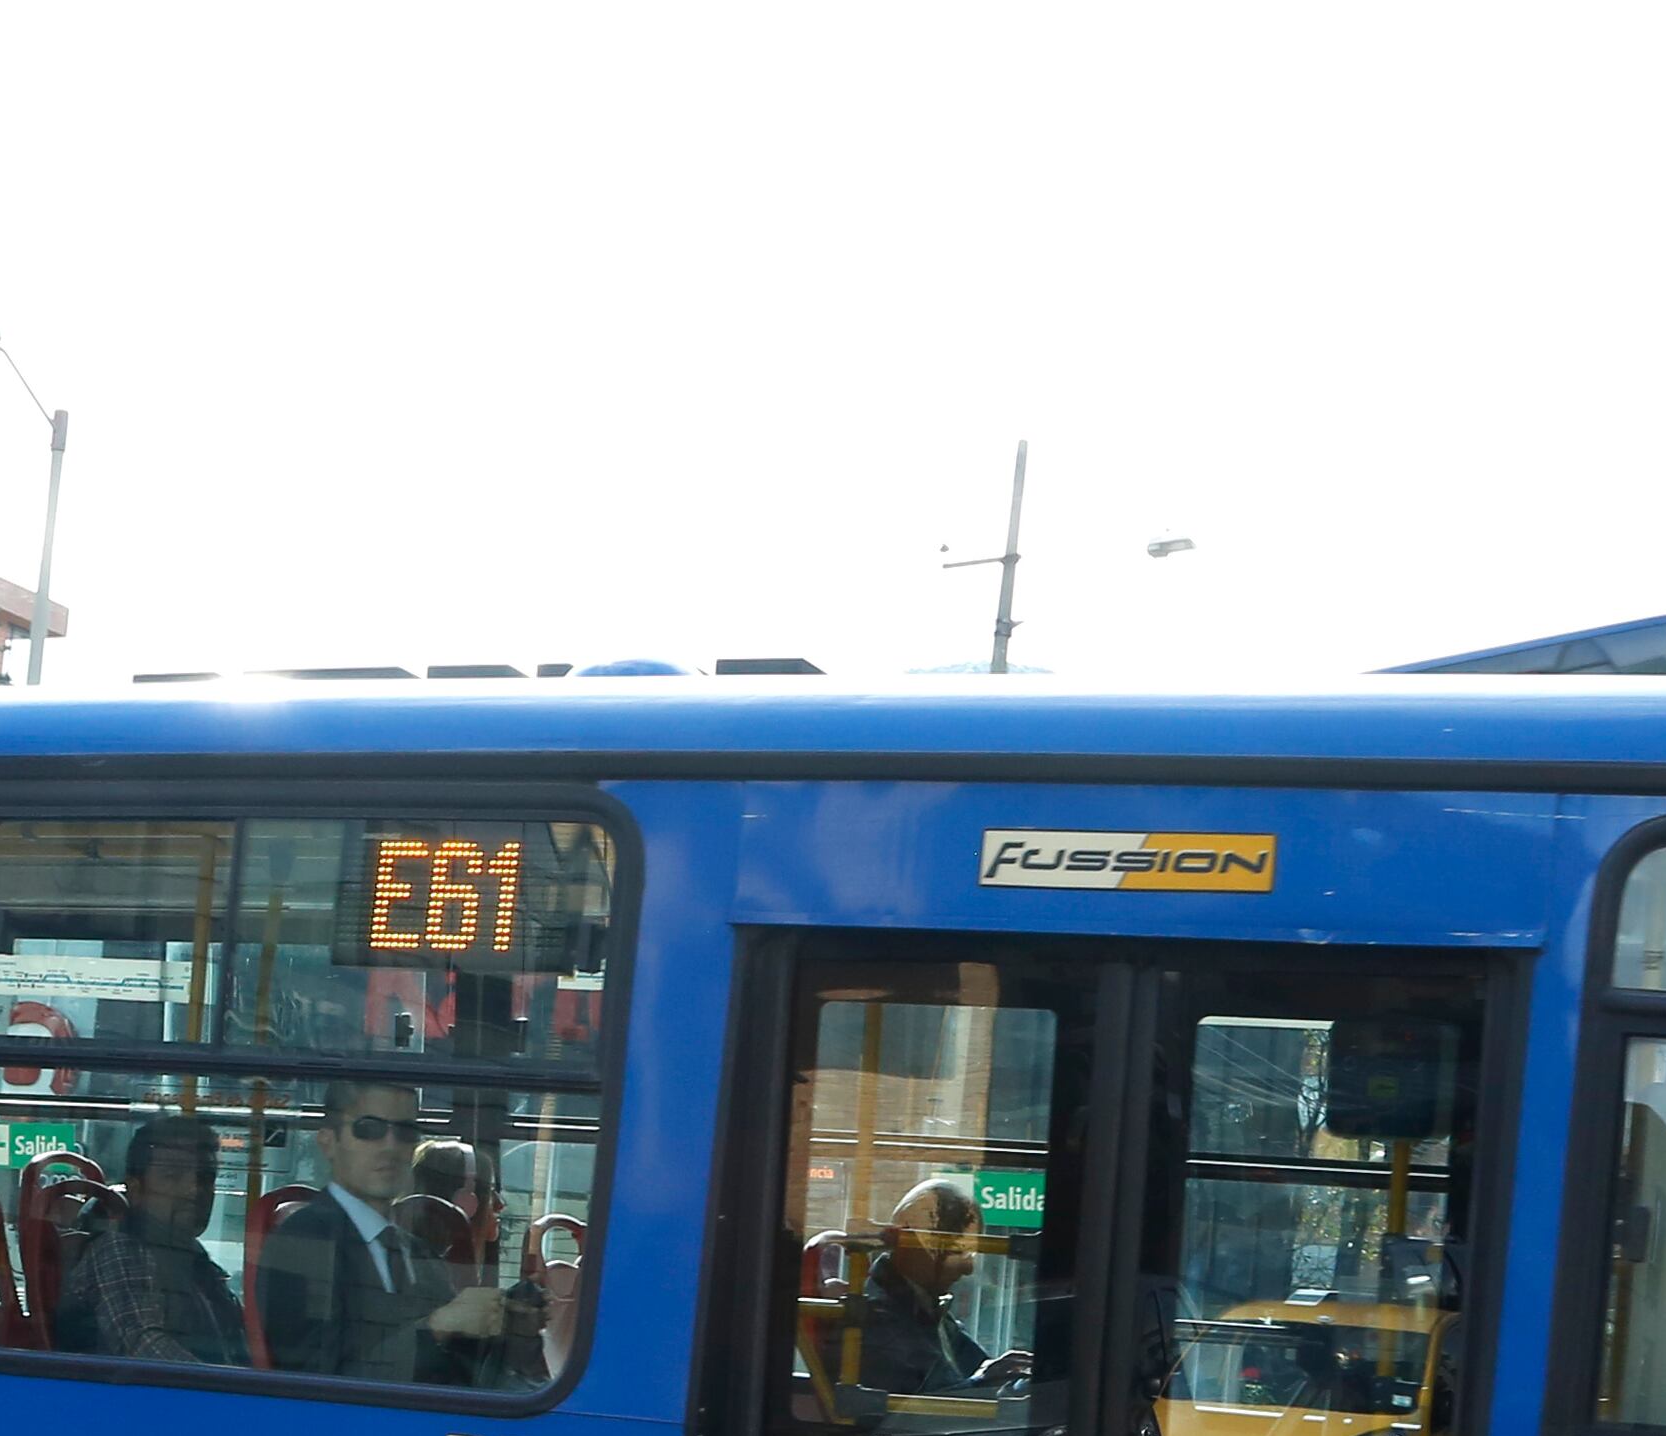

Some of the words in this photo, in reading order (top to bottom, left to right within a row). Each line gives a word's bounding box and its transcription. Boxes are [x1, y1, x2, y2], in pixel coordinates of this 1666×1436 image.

[983, 841, 1269, 878] FUSSION
[370, 841, 521, 951] E61
[14, 1135, 67, 1155] Salida
[981, 1186, 1045, 1212] Salida
